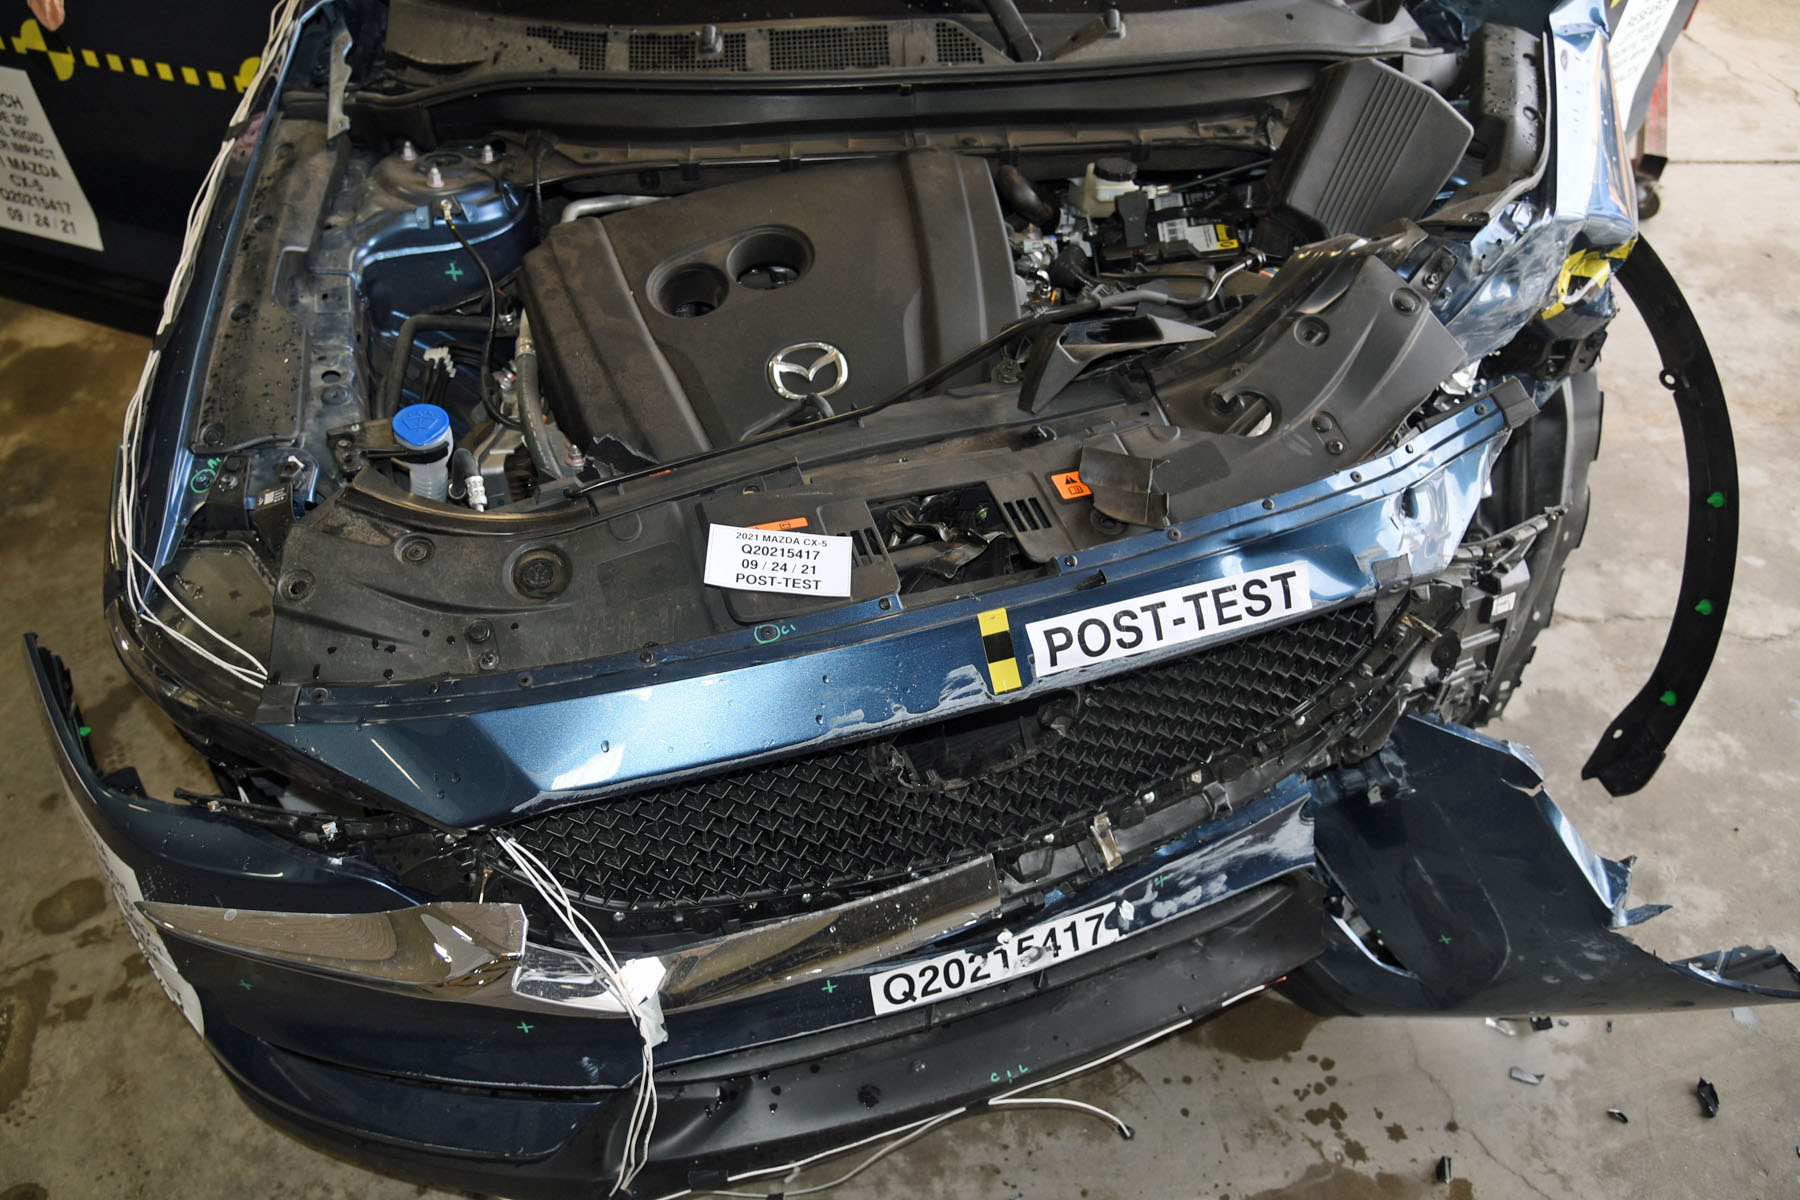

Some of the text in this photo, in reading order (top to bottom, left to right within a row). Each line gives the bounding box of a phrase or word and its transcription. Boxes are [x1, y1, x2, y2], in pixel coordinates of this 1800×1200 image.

[7, 155, 62, 180] MAZDA
[60, 219, 77, 236] 21
[736, 531, 828, 548] 2021 MAZDA CX-5
[741, 544, 821, 561] Q20215417
[741, 558, 758, 570] 09
[771, 561, 788, 573] 24
[801, 564, 816, 575] 21
[735, 573, 822, 590] POST-TEST
[1043, 570, 1297, 667] POST-TEST
